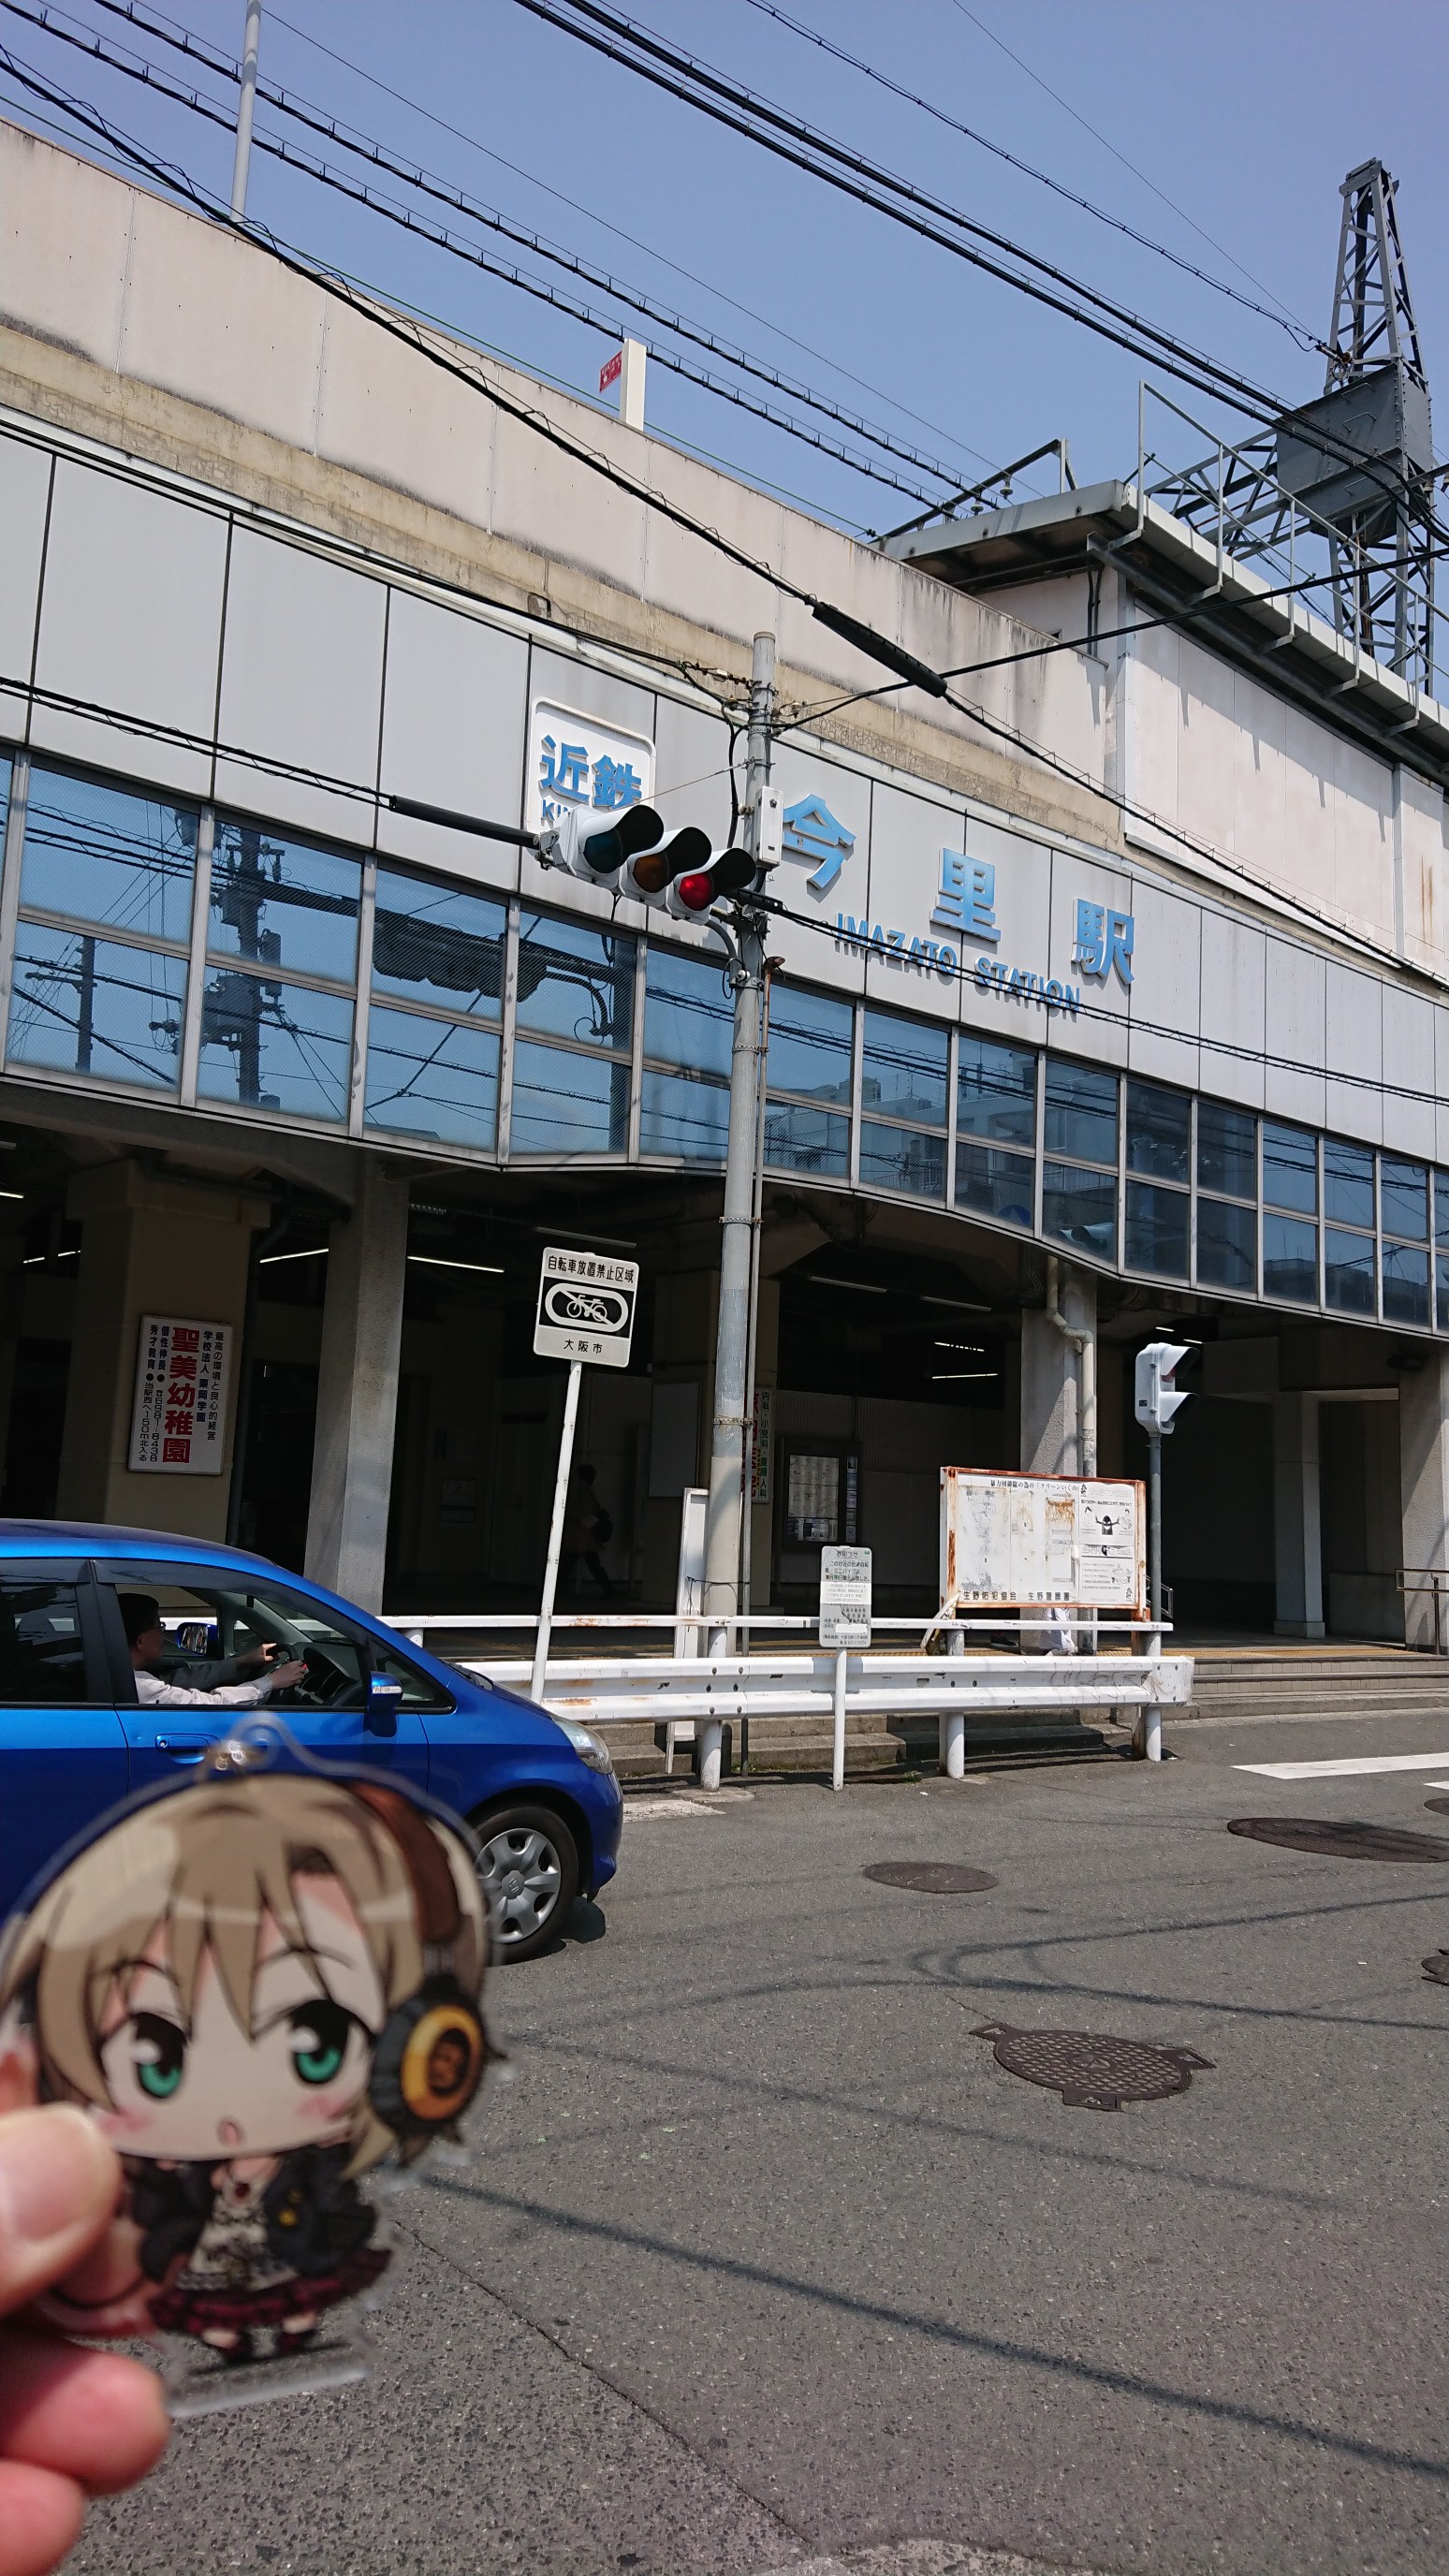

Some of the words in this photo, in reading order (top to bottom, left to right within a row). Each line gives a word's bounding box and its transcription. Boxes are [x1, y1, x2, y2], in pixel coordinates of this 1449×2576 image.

[538, 734, 642, 811] 近鉄
[782, 793, 1134, 986] 今里駅
[834, 912, 959, 976] IMAZATO
[973, 957, 1081, 1011] STATION
[548, 1255, 635, 1283] 自転車放置禁止区域
[147, 1325, 159, 1370] 秀才教育
[157, 1325, 170, 1370] 個性伸長
[199, 1330, 213, 1374] 学校法人
[564, 1339, 603, 1354] 大阪市
[162, 1326, 200, 1463] 聖美幼稚園
[207, 1331, 225, 1441] 最高の環境と良心的経営
[963, 1590, 1017, 1601] 生野防犯協会
